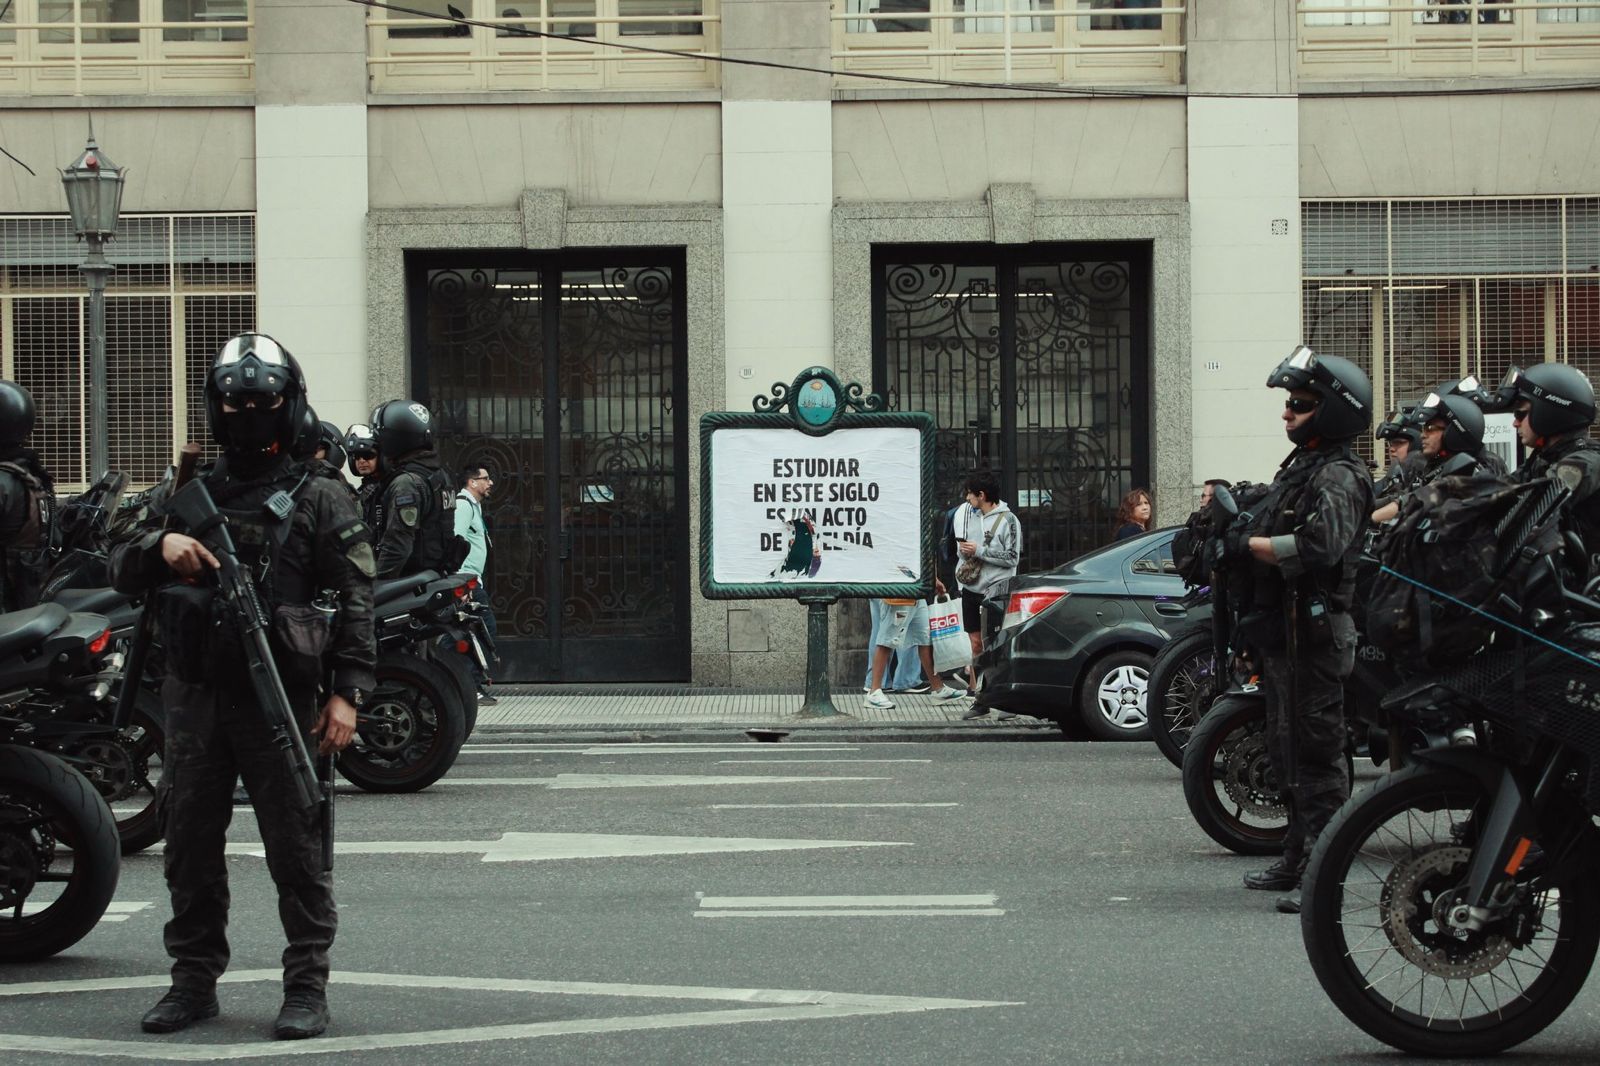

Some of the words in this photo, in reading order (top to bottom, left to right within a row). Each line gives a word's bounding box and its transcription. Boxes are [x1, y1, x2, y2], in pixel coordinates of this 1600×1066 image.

[773, 458, 860, 478] ESTUDIAR
[753, 483, 776, 503] EN
[782, 483, 824, 503] ESTE
[828, 482, 880, 503] SIGLO
[822, 507, 867, 527] ACTO
[760, 532, 783, 552] DE
